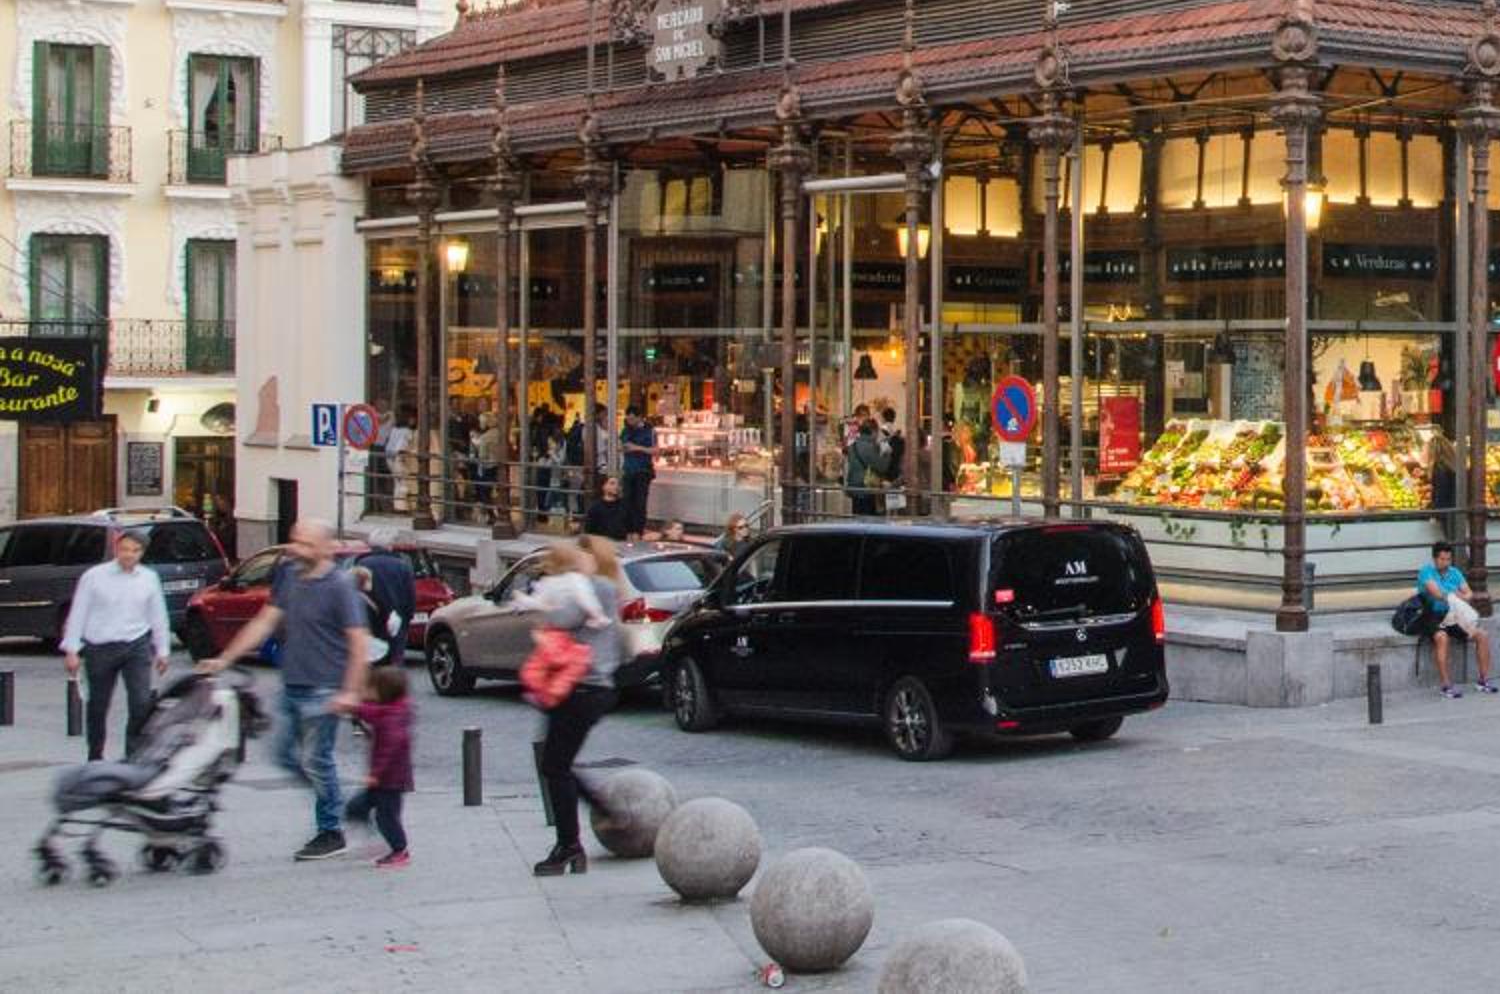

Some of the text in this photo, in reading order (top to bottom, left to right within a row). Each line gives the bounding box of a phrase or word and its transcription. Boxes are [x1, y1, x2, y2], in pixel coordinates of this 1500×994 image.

[655, 40, 704, 63] SAN MIGUEL
[318, 407, 331, 442] P
